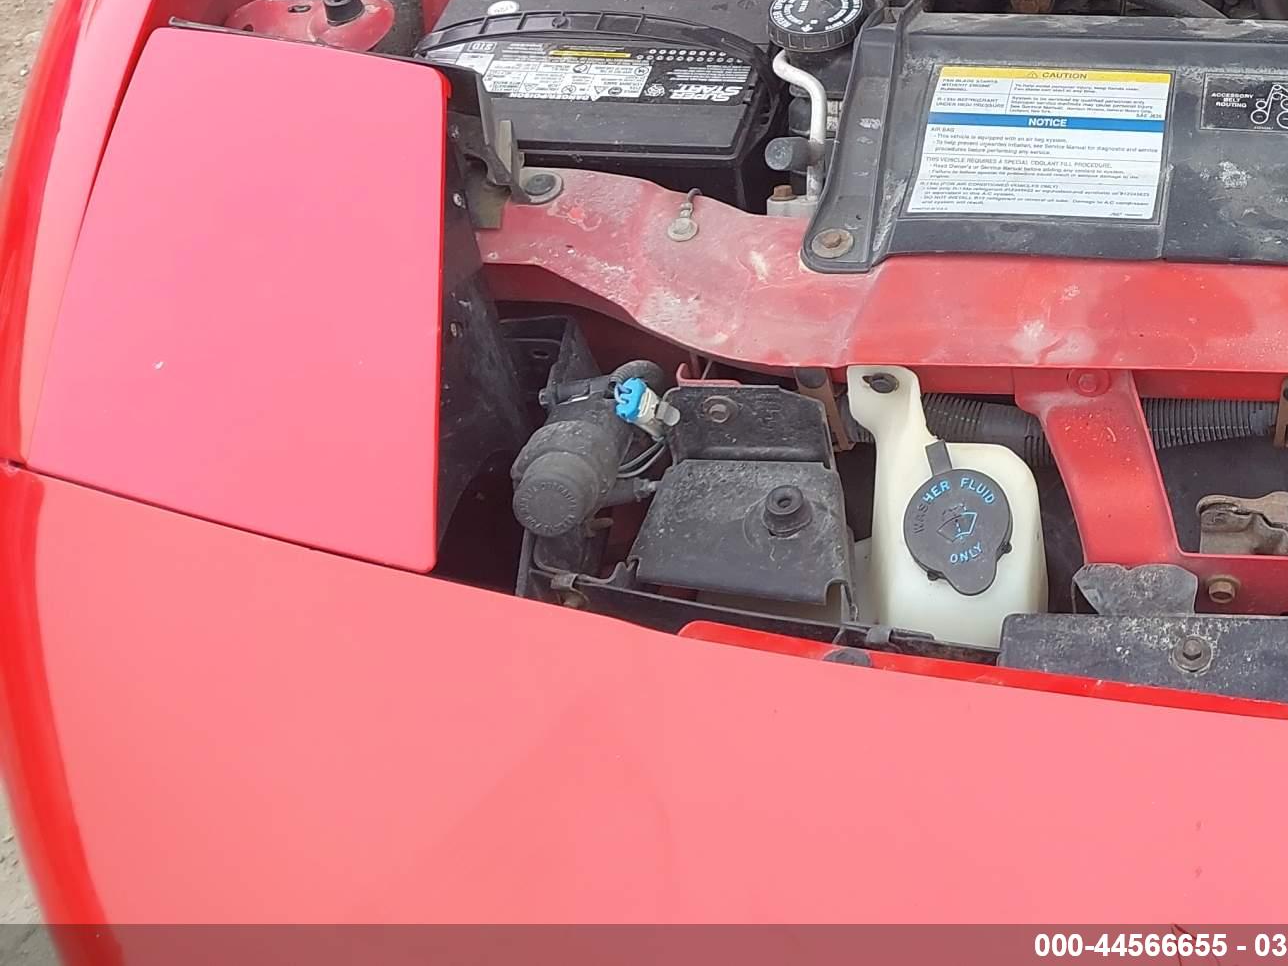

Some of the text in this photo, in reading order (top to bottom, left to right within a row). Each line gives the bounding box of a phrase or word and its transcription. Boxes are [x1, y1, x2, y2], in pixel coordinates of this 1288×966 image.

[1042, 71, 1087, 79] CAUTION
[676, 83, 743, 95] START
[671, 92, 730, 102] SUPER
[1028, 118, 1067, 127] NOTICE
[960, 477, 996, 505] FLUID
[949, 541, 983, 565] ONLY
